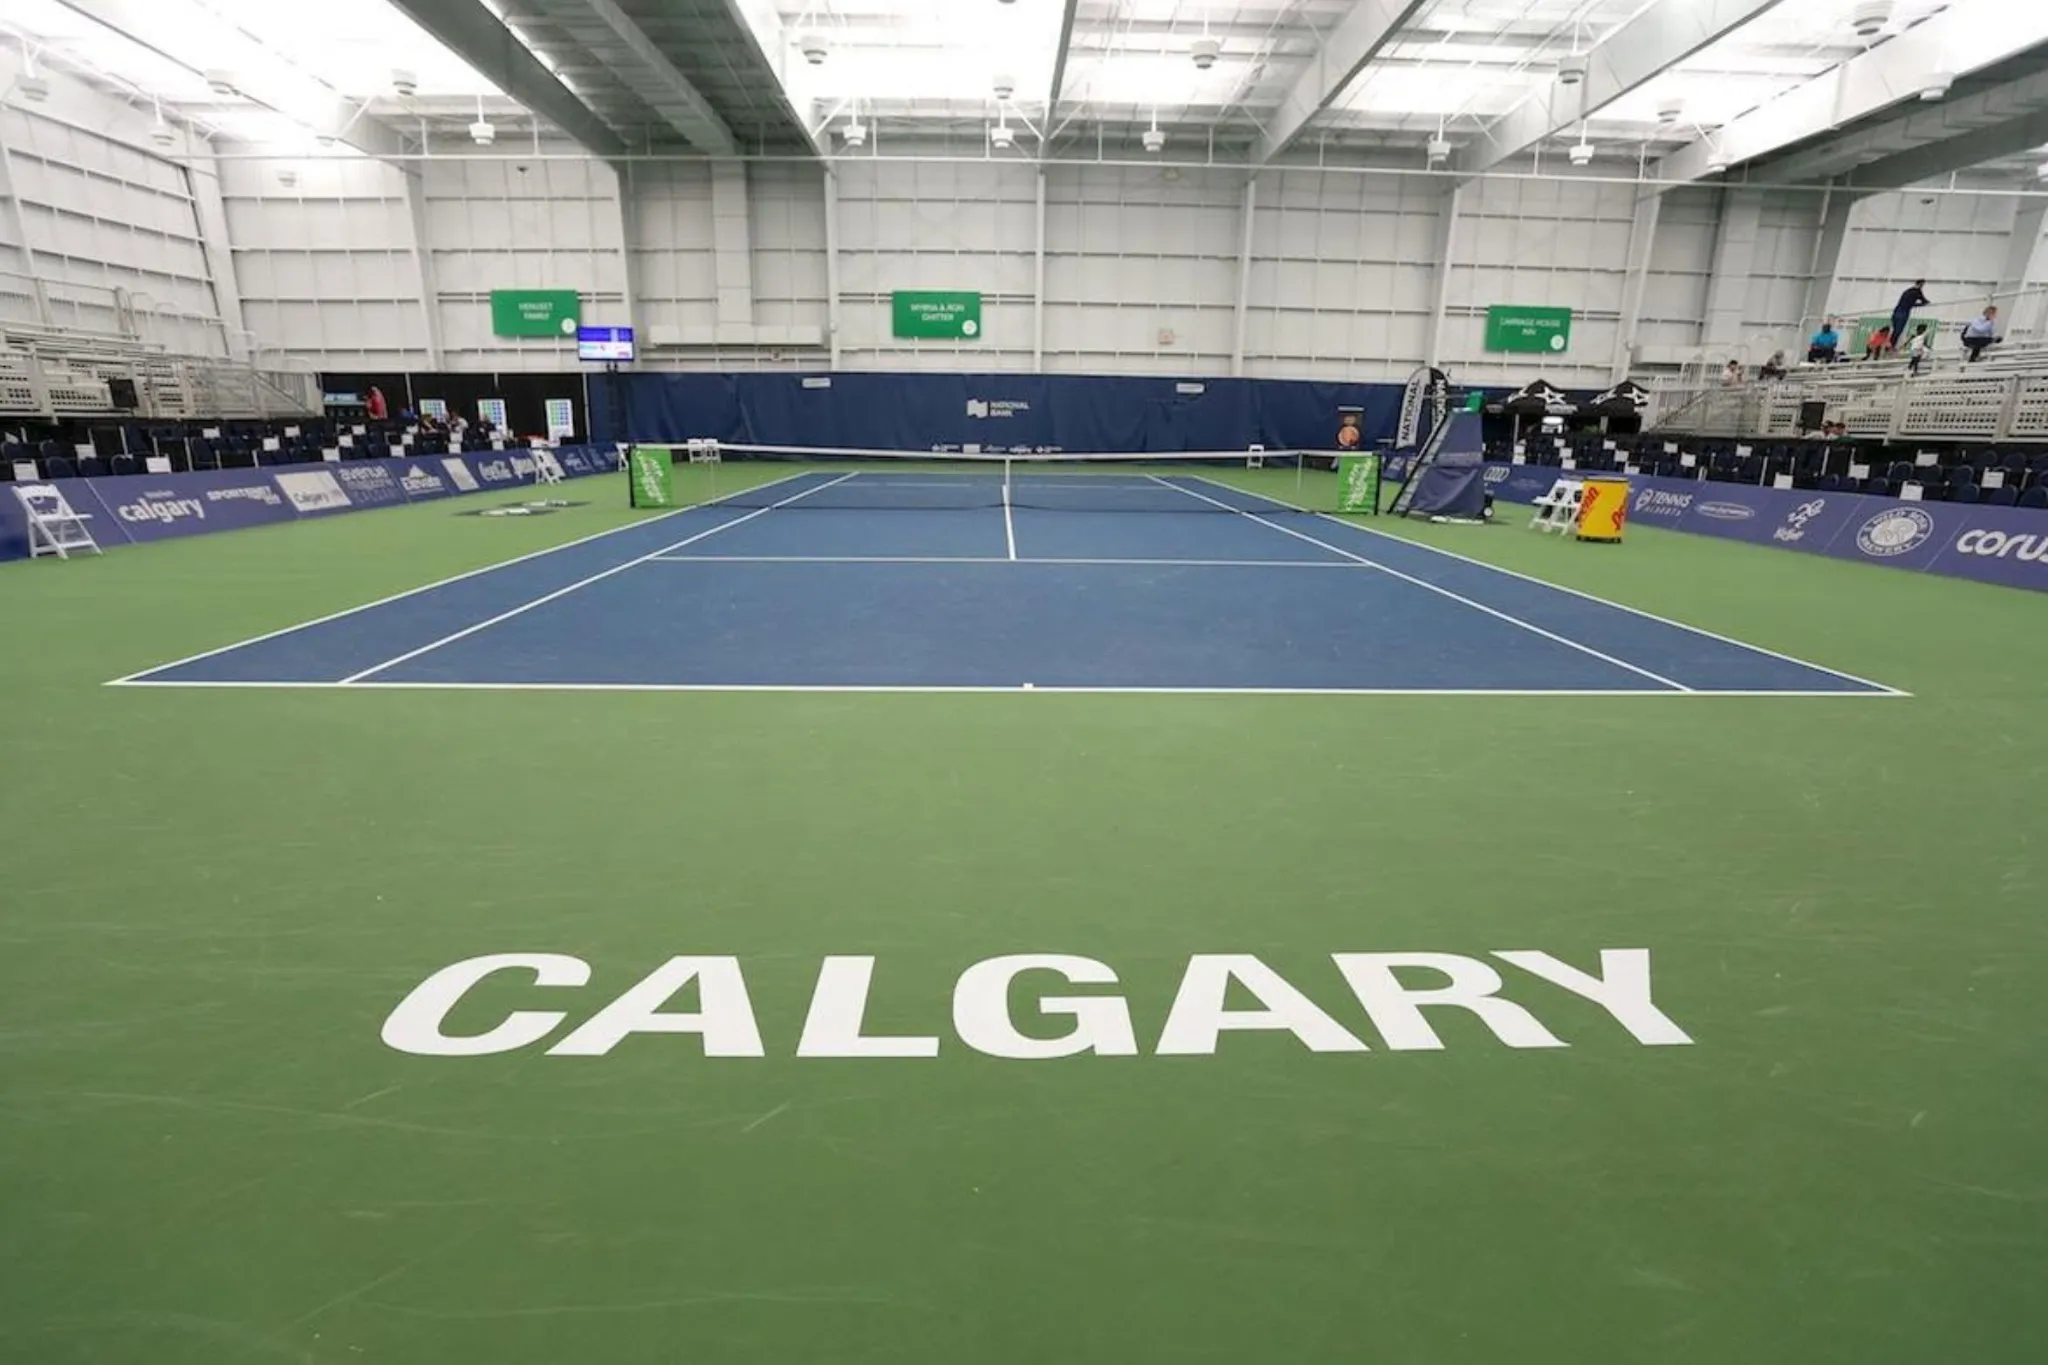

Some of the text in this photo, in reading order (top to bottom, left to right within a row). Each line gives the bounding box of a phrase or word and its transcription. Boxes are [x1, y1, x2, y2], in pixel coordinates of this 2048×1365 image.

[1401, 380, 1419, 441] NATIONAL
[119, 498, 205, 524] calgary
[1652, 491, 1693, 508] TENNIS
[381, 949, 1693, 1058] CALGARY
